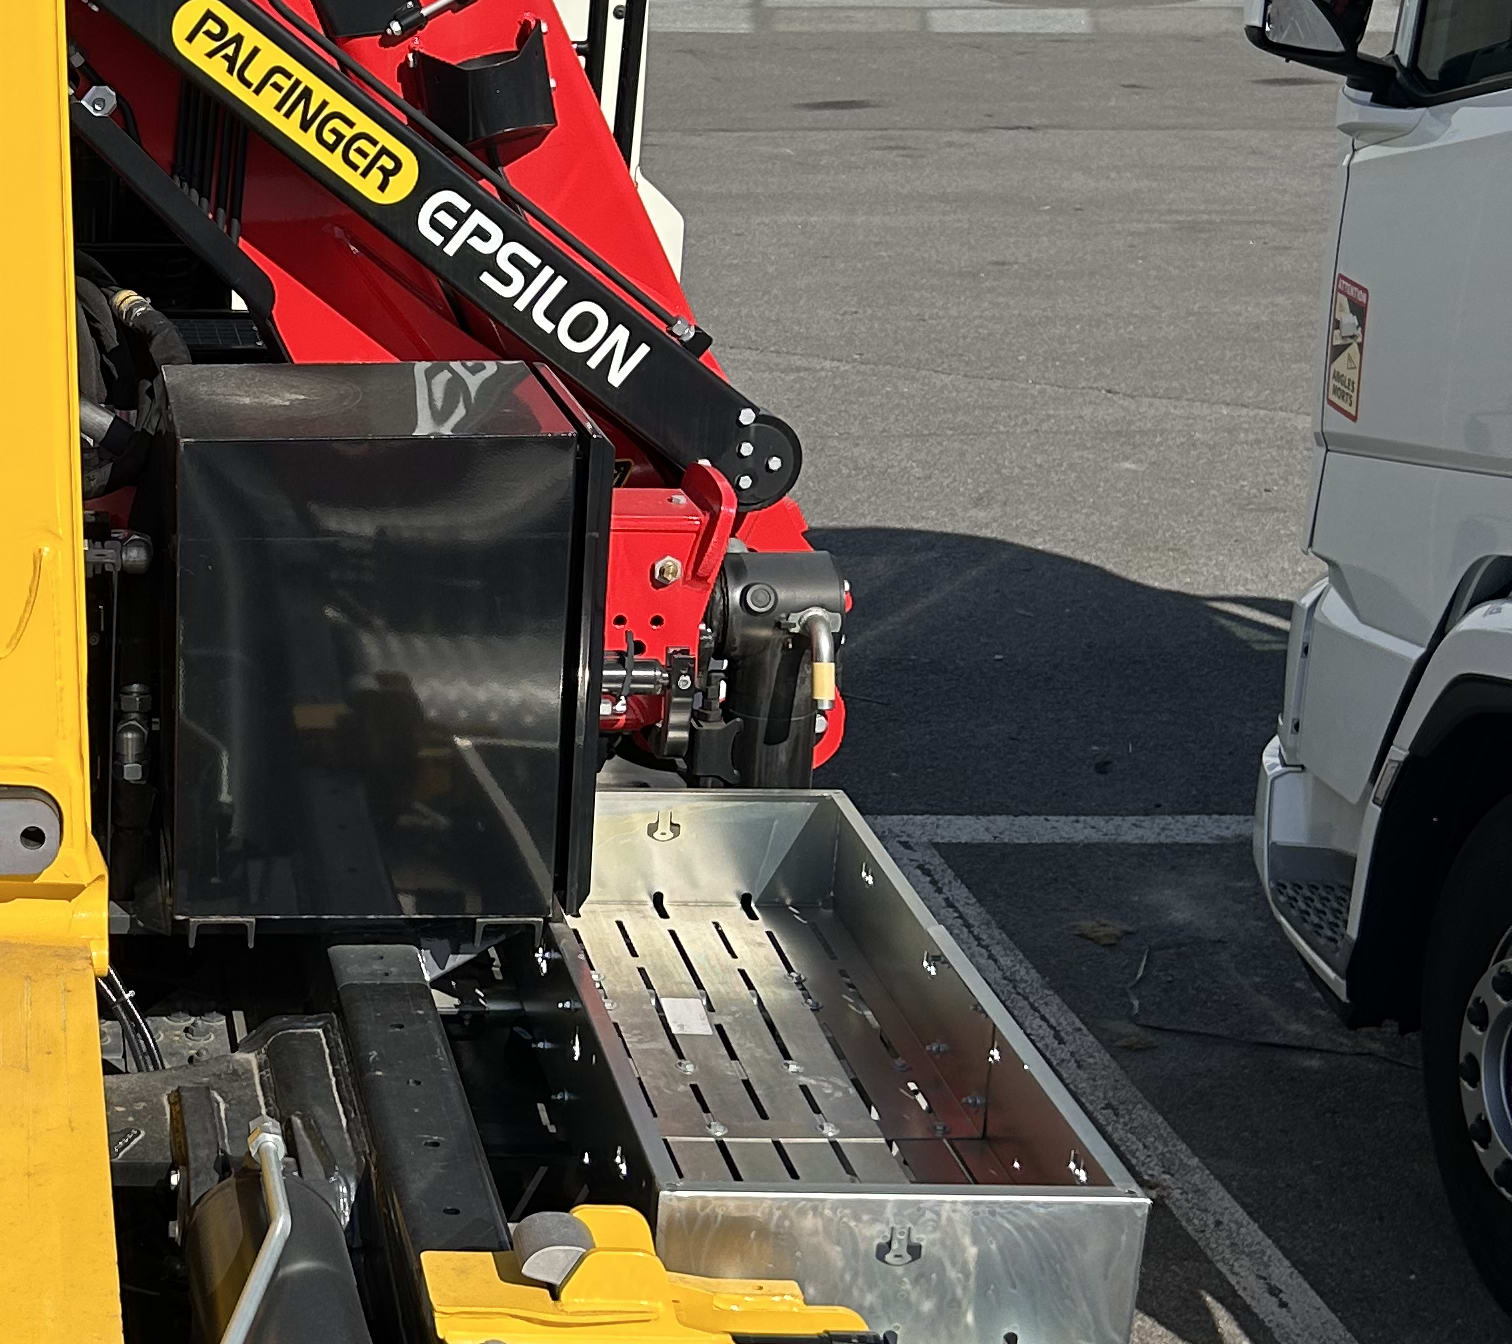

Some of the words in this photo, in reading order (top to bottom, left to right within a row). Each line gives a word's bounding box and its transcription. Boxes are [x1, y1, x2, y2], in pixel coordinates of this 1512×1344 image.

[185, 7, 403, 194] PALFINGER
[417, 189, 651, 389] EPSILON
[1332, 368, 1355, 393] ANGLES
[1332, 384, 1353, 407] MORTS
